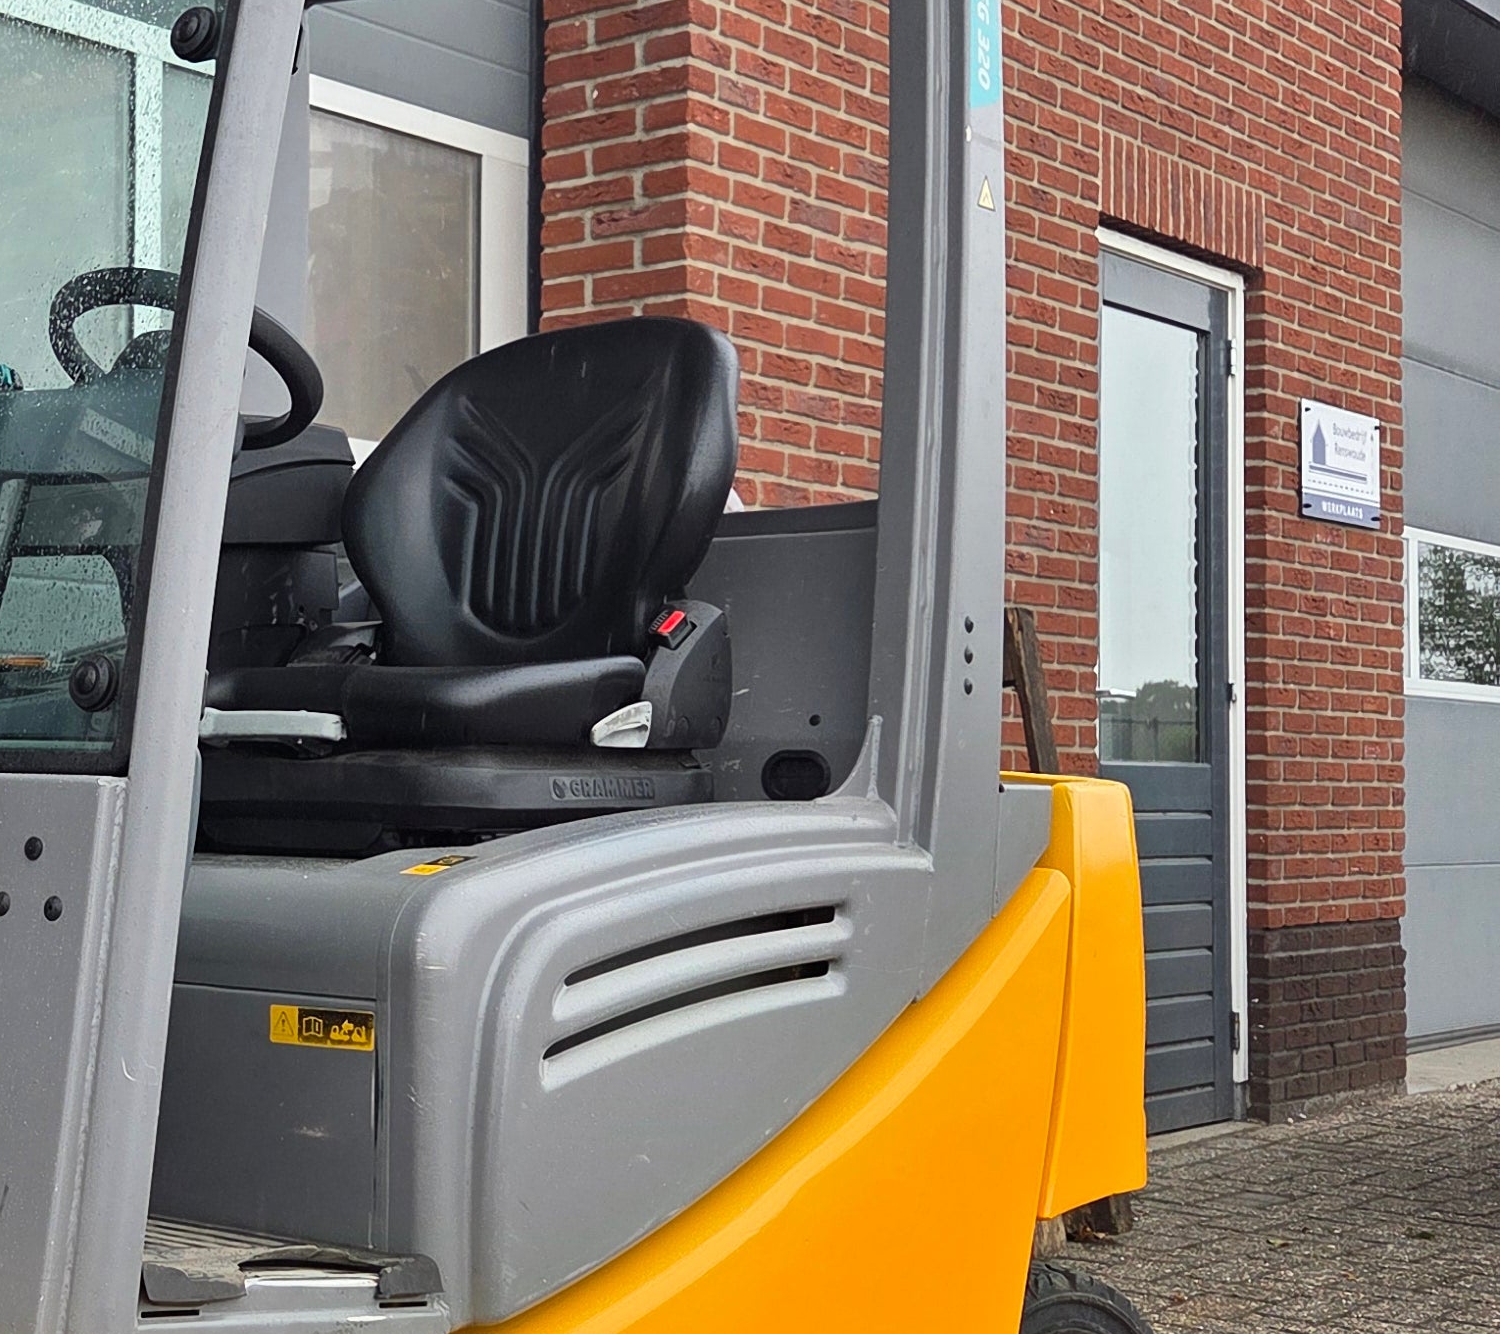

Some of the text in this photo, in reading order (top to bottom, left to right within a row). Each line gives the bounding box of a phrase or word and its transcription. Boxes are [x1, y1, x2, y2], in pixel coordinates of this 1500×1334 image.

[977, 28, 991, 90] 320
[1321, 500, 1364, 520] WERKPLAATS
[569, 778, 655, 799] GRAMMER
